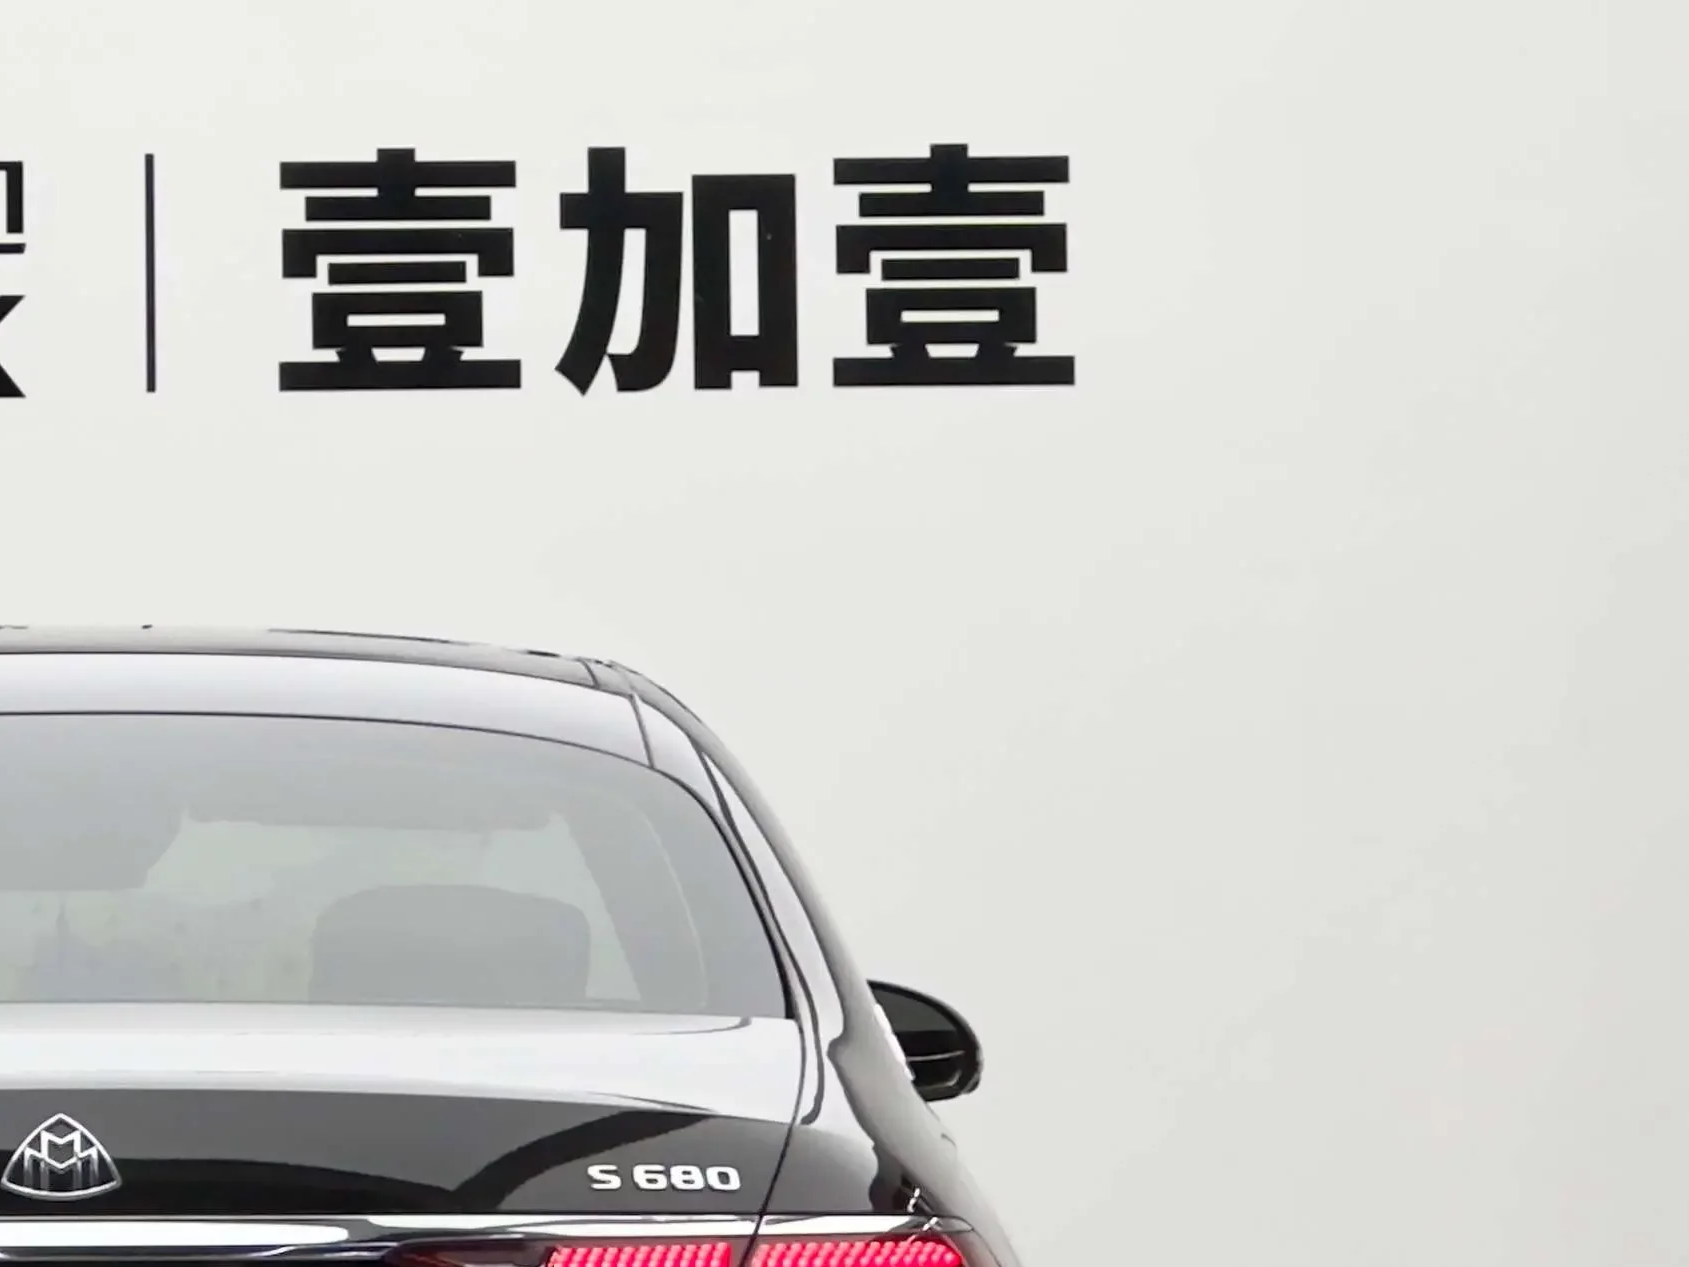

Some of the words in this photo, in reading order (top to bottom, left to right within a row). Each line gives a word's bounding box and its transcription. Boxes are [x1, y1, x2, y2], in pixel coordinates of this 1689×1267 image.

[279, 143, 1075, 396] 壹加壹
[587, 1164, 622, 1190] S
[632, 1164, 742, 1191] 680
